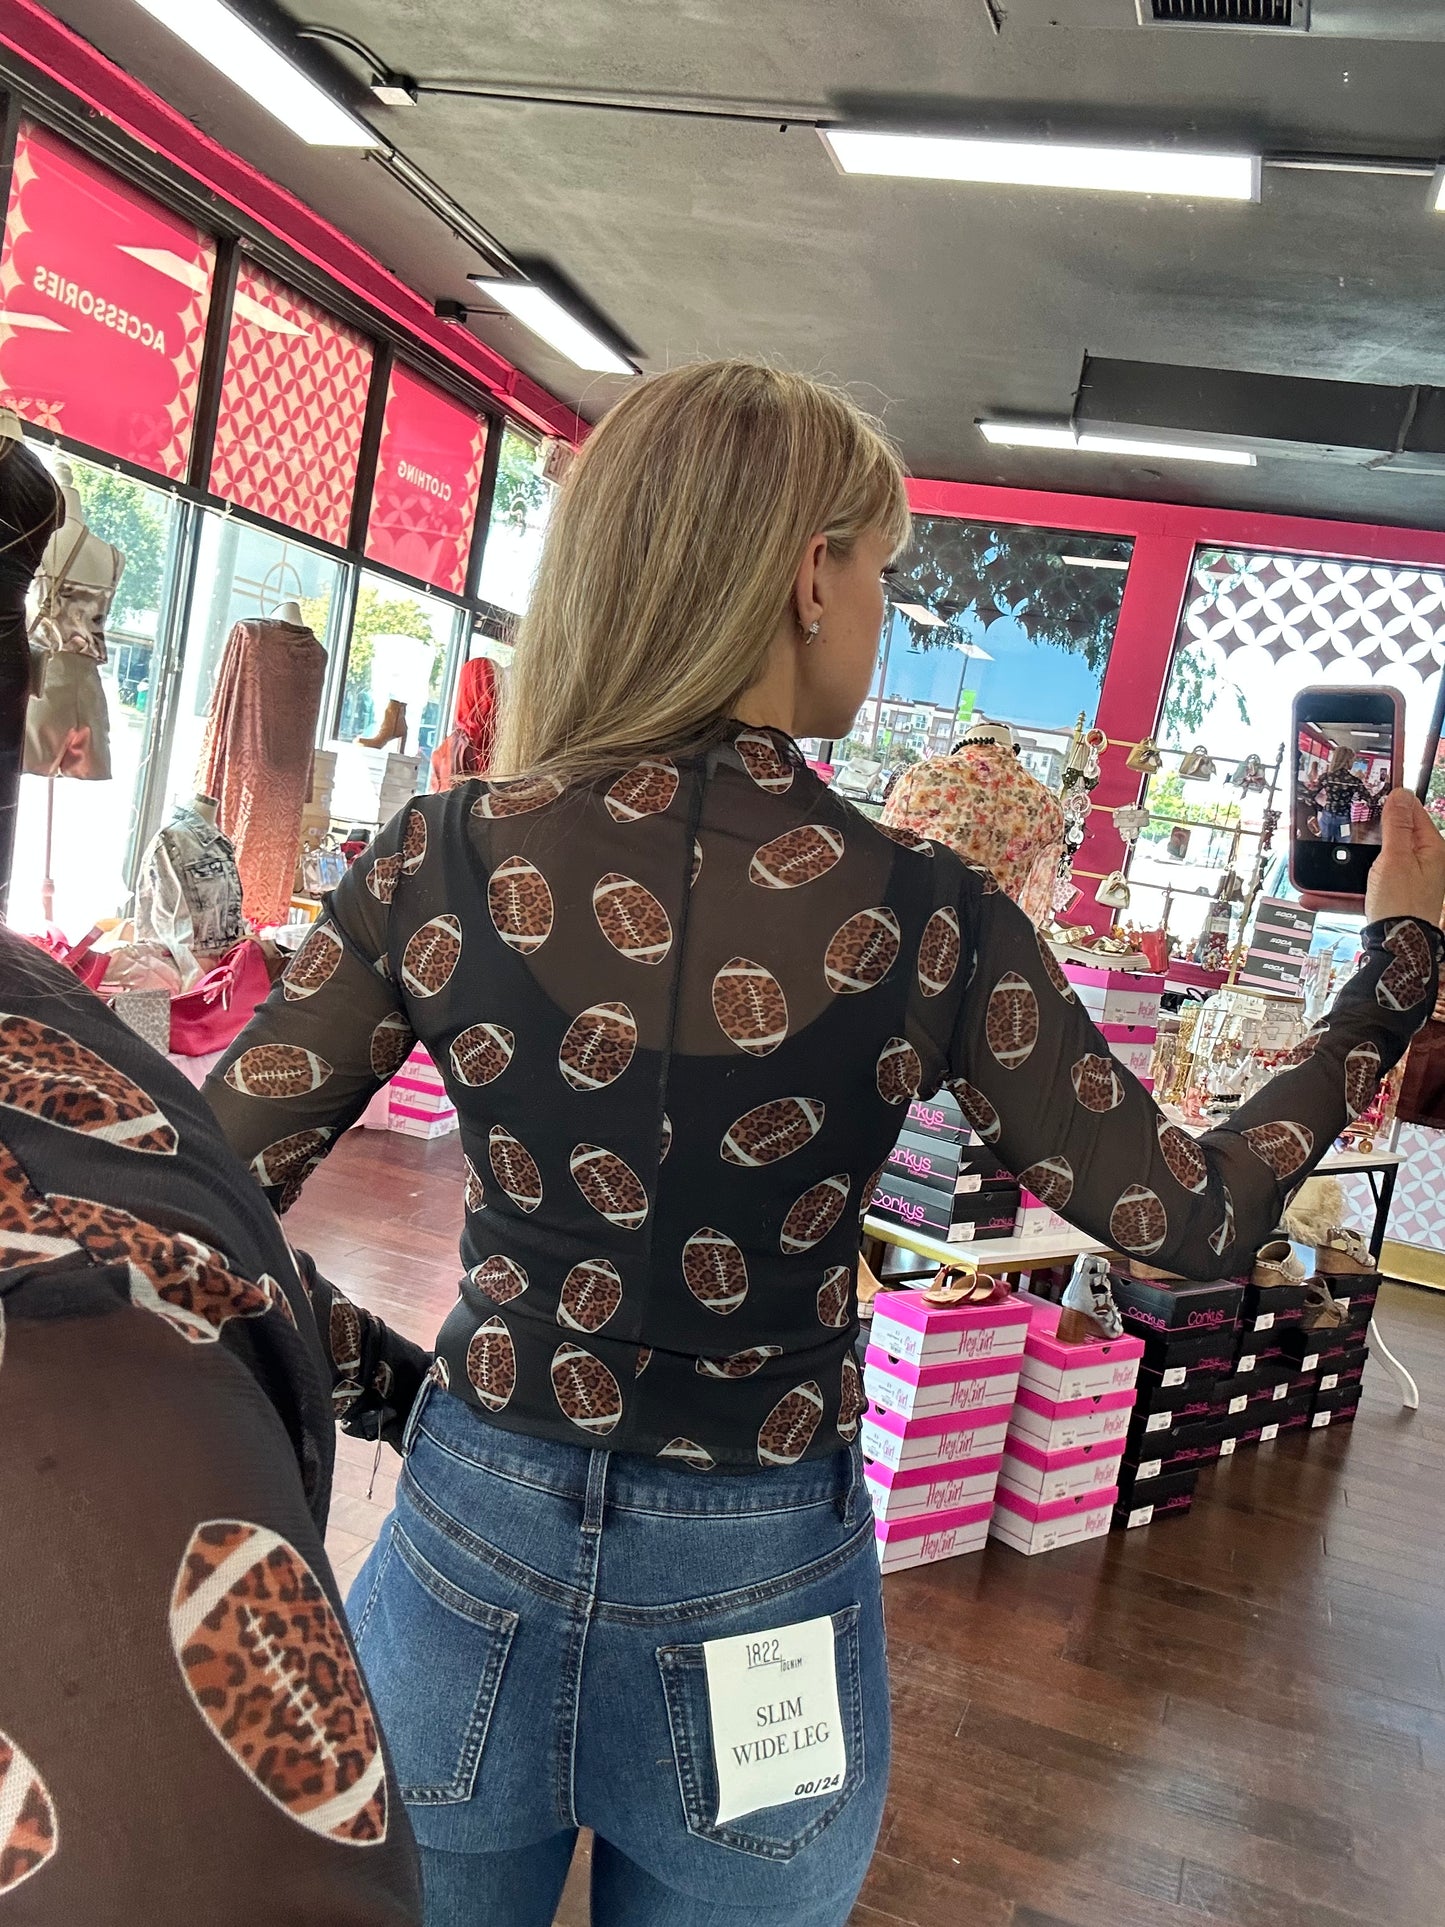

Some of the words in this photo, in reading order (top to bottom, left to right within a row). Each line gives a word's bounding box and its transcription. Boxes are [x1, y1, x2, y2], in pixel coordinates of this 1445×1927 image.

[908, 1102, 944, 1126] rkys
[889, 1147, 931, 1171] orkys
[871, 1187, 925, 1220] Corkys
[1188, 1308, 1225, 1327] Corkys
[746, 1639, 780, 1667] 1822
[756, 1696, 803, 1727] SLIM
[731, 1733, 789, 1766] WIDE
[793, 1721, 830, 1750] LEG
[794, 1774, 840, 1796] 00/24
